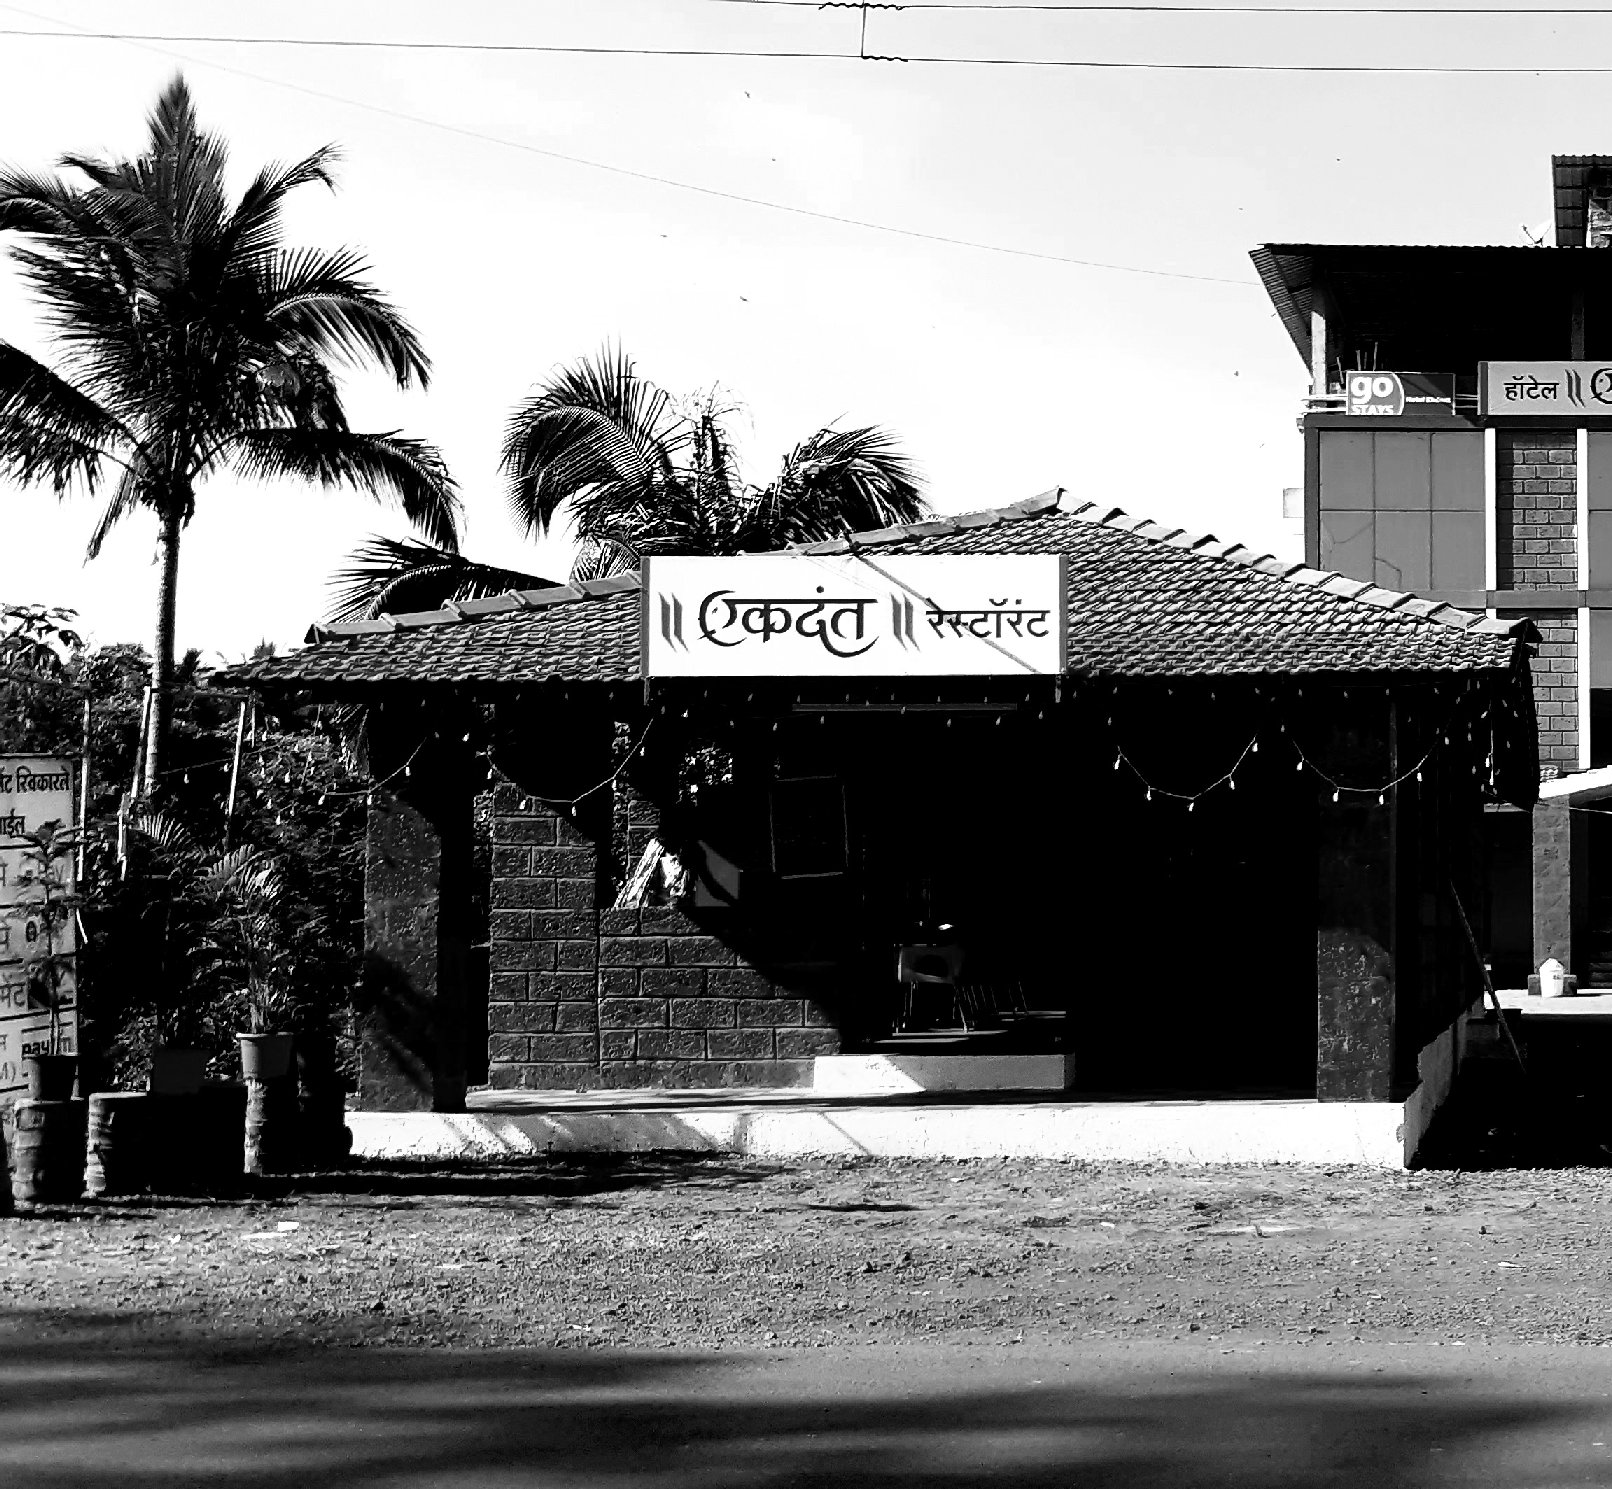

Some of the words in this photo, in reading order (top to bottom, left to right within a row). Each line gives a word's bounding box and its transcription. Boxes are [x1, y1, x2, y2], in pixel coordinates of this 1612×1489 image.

[1350, 377, 1394, 405] go
[1503, 375, 1559, 401] हॉटेल
[1351, 405, 1394, 415] STAYS
[698, 585, 879, 658] एकदंत
[926, 597, 1051, 638] रेस्टॉरंट
